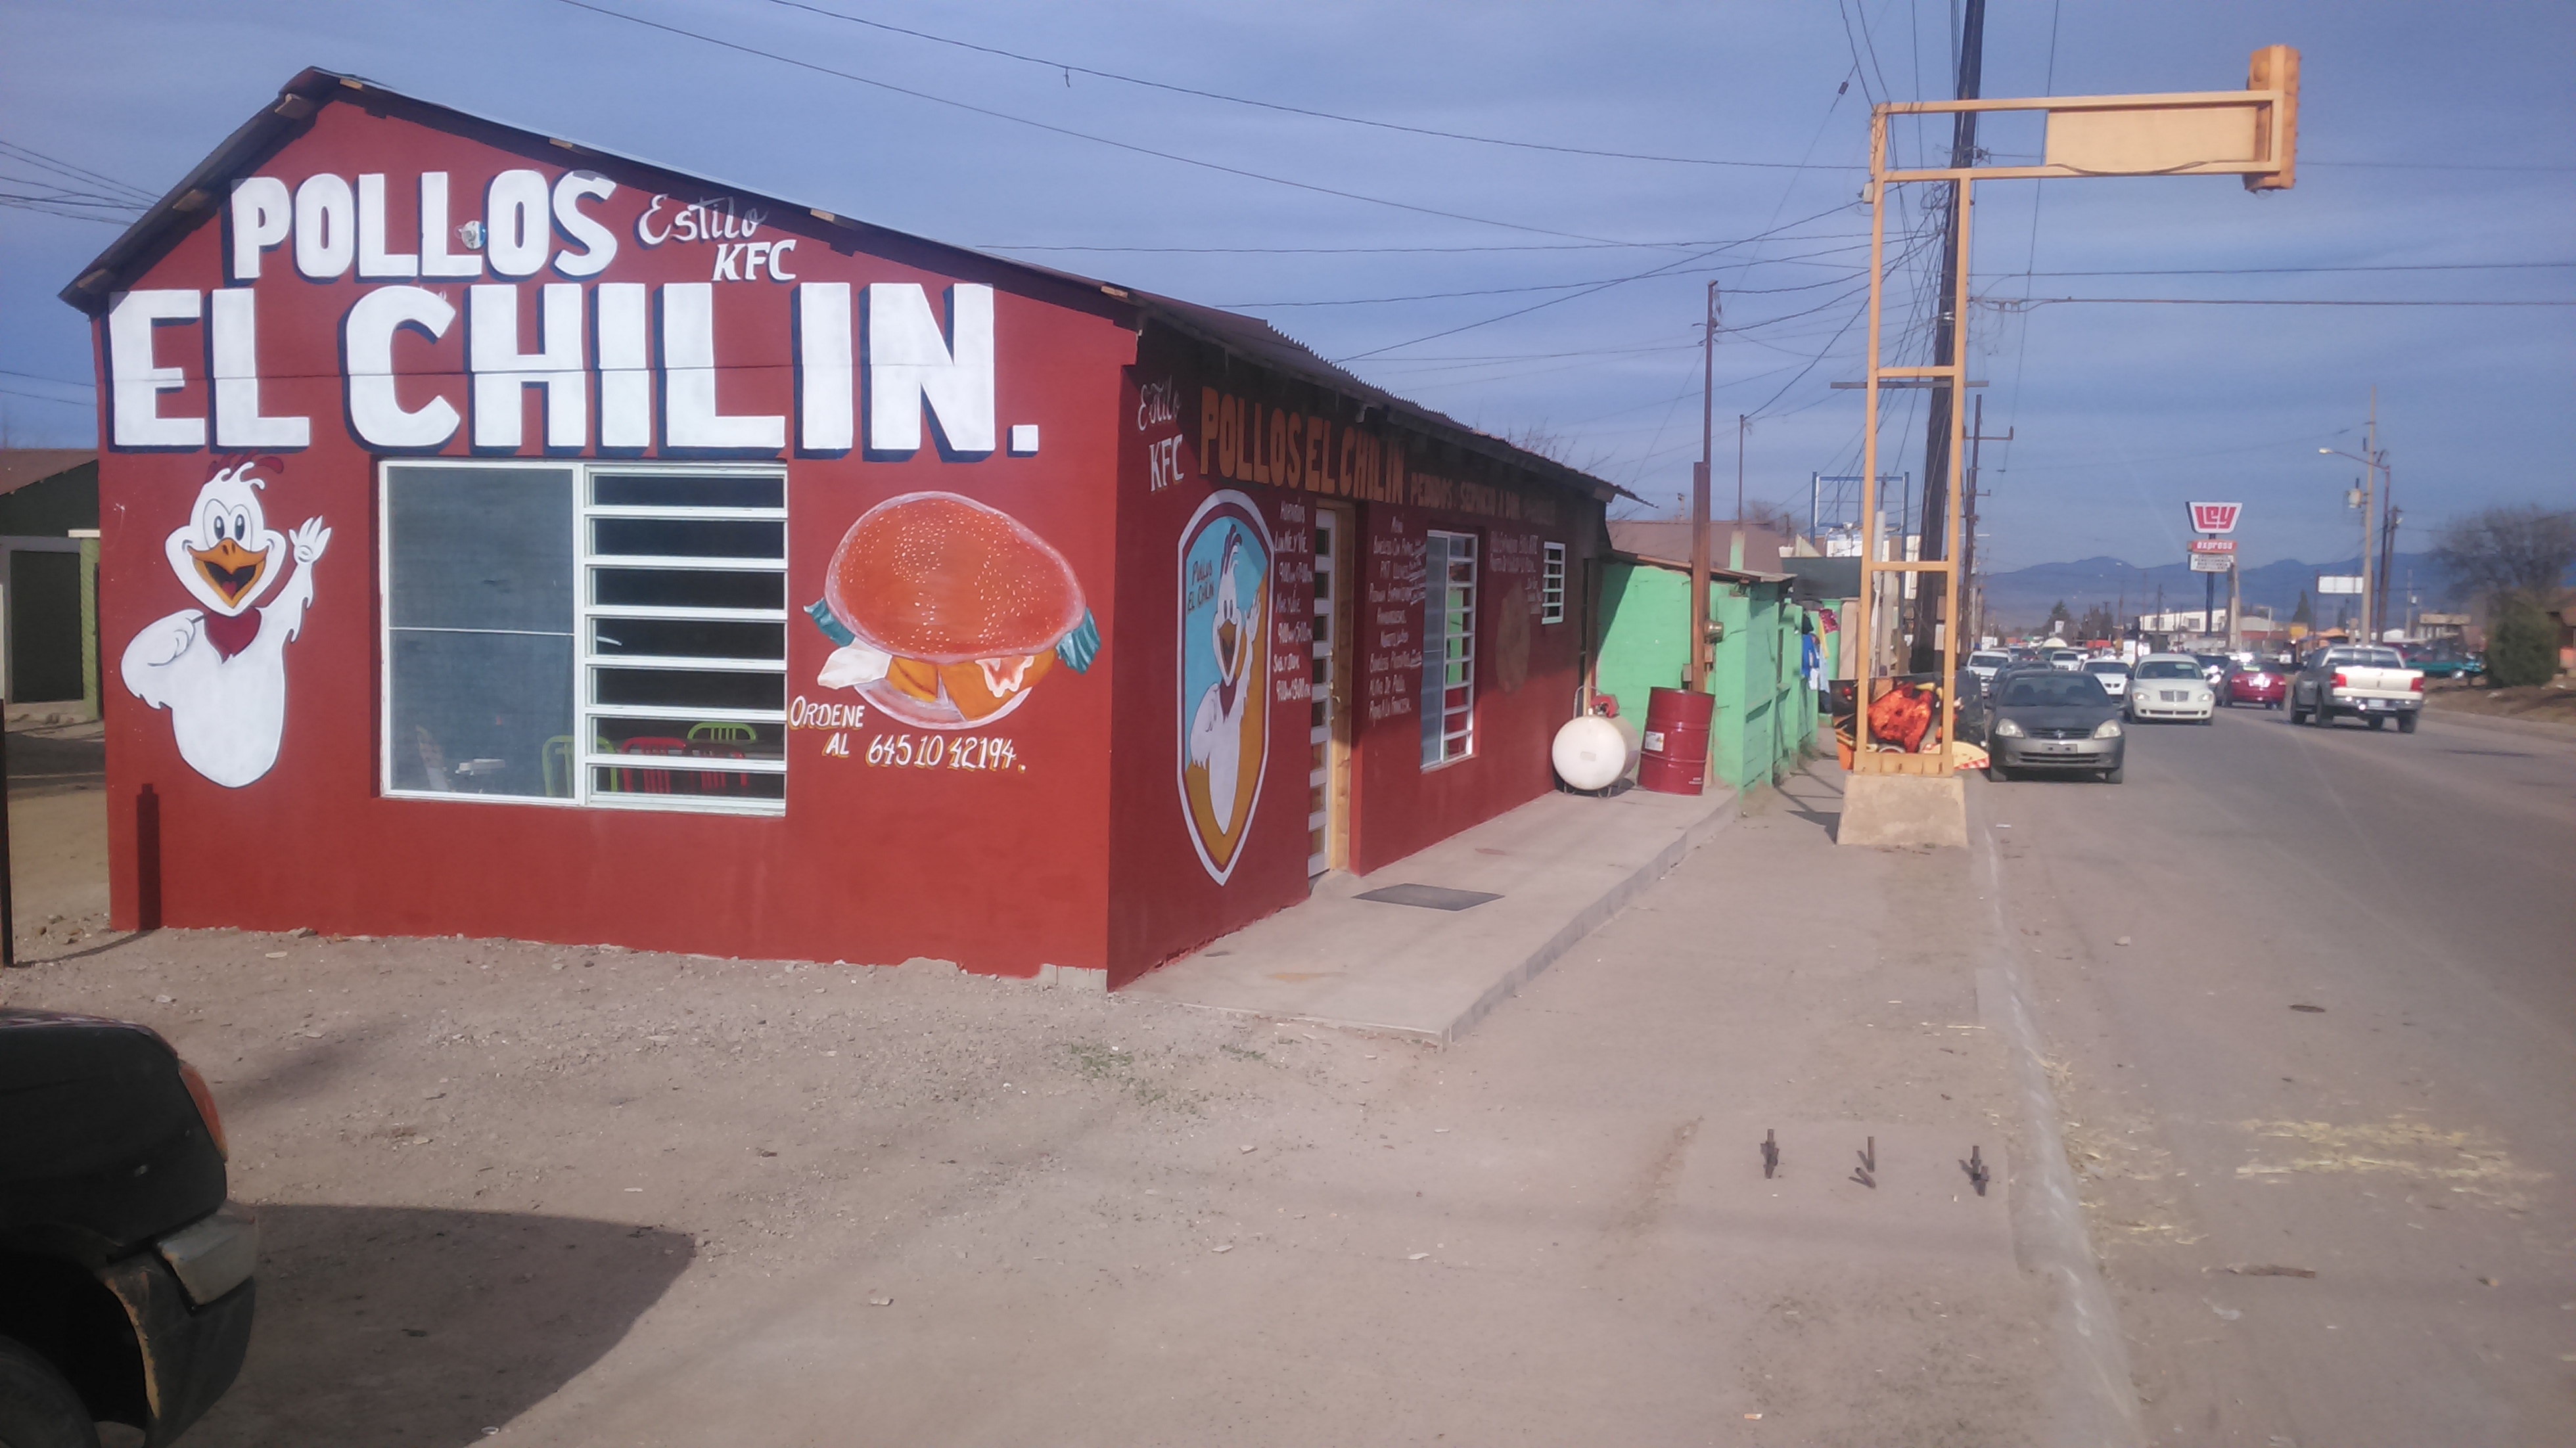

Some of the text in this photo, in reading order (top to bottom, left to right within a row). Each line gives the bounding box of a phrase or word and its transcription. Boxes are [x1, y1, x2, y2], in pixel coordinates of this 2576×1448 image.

[227, 168, 618, 281] POLLOS
[637, 193, 768, 247] Estilo
[712, 238, 796, 283] KFC
[105, 283, 1039, 459] EL CHILIN.
[1149, 434, 1184, 491] KFC
[1200, 386, 1302, 489] POLLOS
[1305, 416, 1336, 494] EL
[1339, 426, 1405, 505] CHILIN
[789, 695, 865, 730] ORDENE
[823, 732, 850, 758] AL
